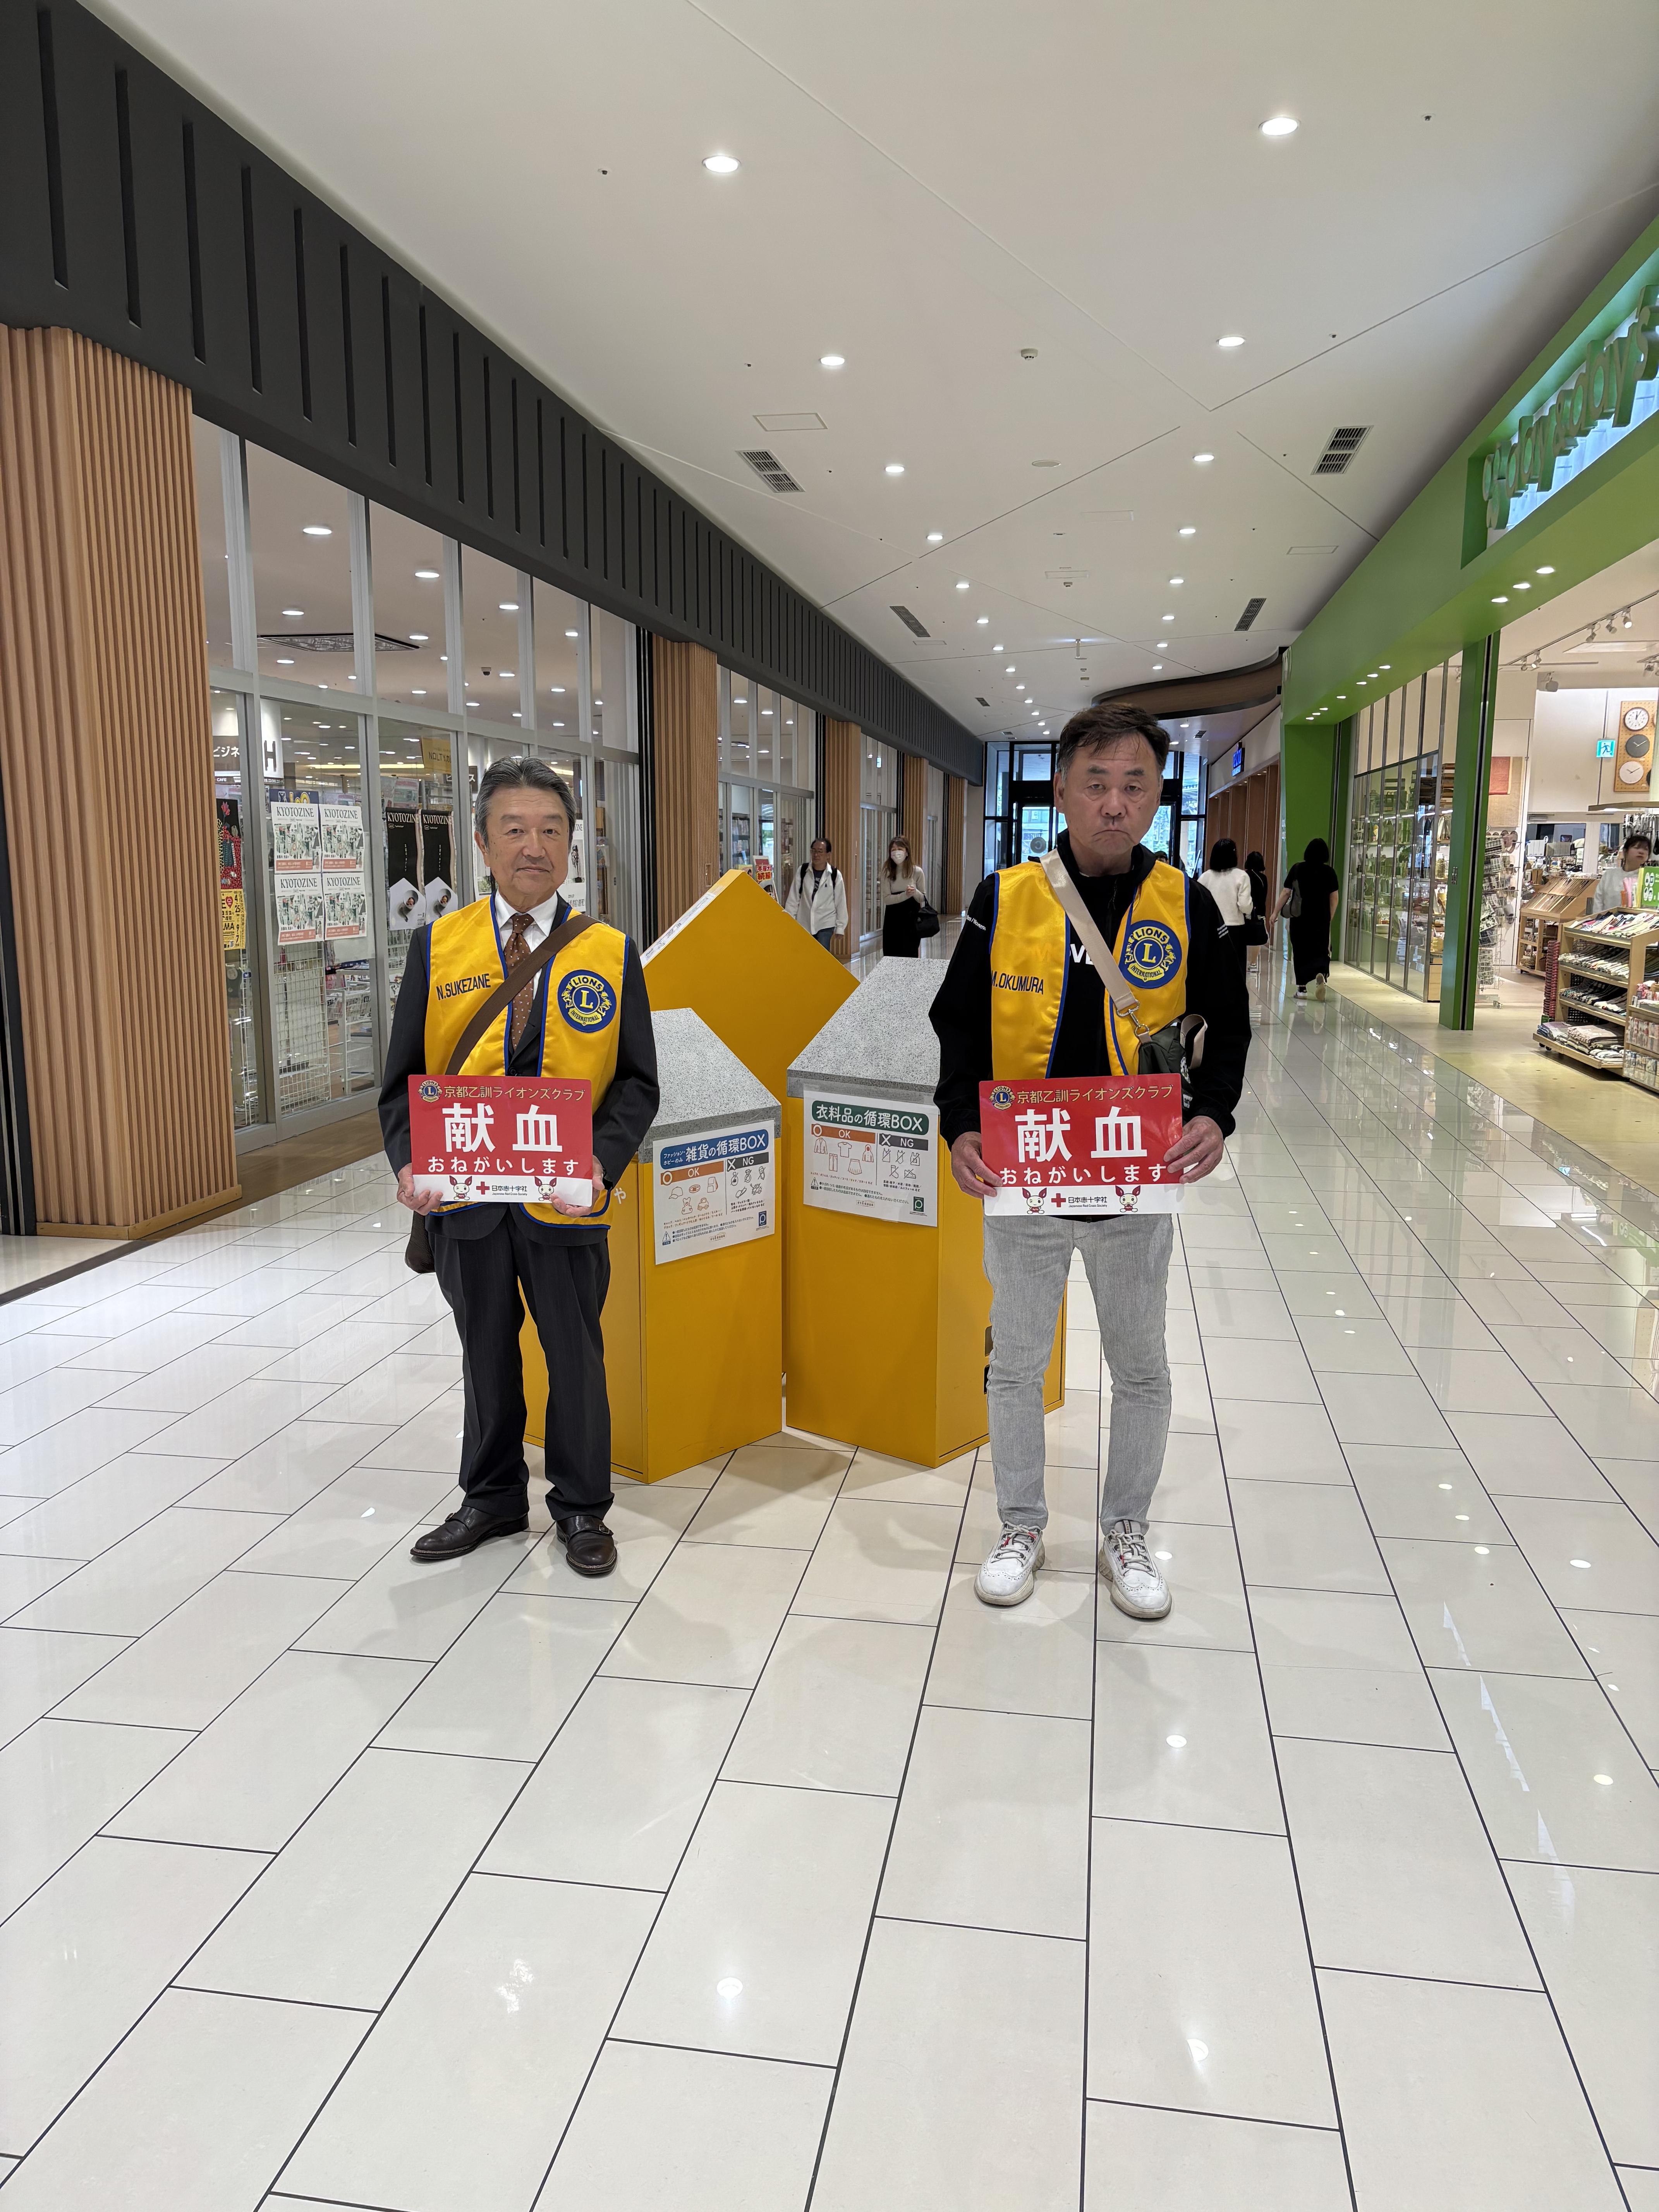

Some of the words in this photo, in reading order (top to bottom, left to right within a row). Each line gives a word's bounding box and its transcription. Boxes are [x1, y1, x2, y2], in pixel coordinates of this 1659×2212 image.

[276, 807, 314, 817] KYOTOZINE
[324, 809, 358, 819] KYOTOZINE
[280, 878, 318, 888] KYOTOZINE
[327, 877, 361, 886] KYOTOZINE
[1135, 927, 1168, 943] LIONS
[1142, 943, 1156, 963] L
[1130, 965, 1163, 978] INTERNATIONAL
[436, 973, 491, 1001] N.SUKEZANE
[572, 976, 603, 990] LIONS
[580, 989, 594, 1009] L
[570, 1010, 600, 1022] INTERNATIONAL
[443, 1085, 586, 1101] 京都乙訓ライオンズクラブ
[1017, 1084, 1174, 1104] 京都乙訓ライオンズクラブ
[816, 1104, 923, 1132] 衣料品の循環BOX
[838, 1129, 850, 1139] OK
[686, 1133, 766, 1162] 雑貨の循環BOX
[900, 1138, 914, 1147] NG
[428, 1156, 579, 1176] おねがいします
[742, 1156, 754, 1166] NG
[687, 1167, 700, 1178] OK
[999, 1163, 1167, 1185] おねがいします
